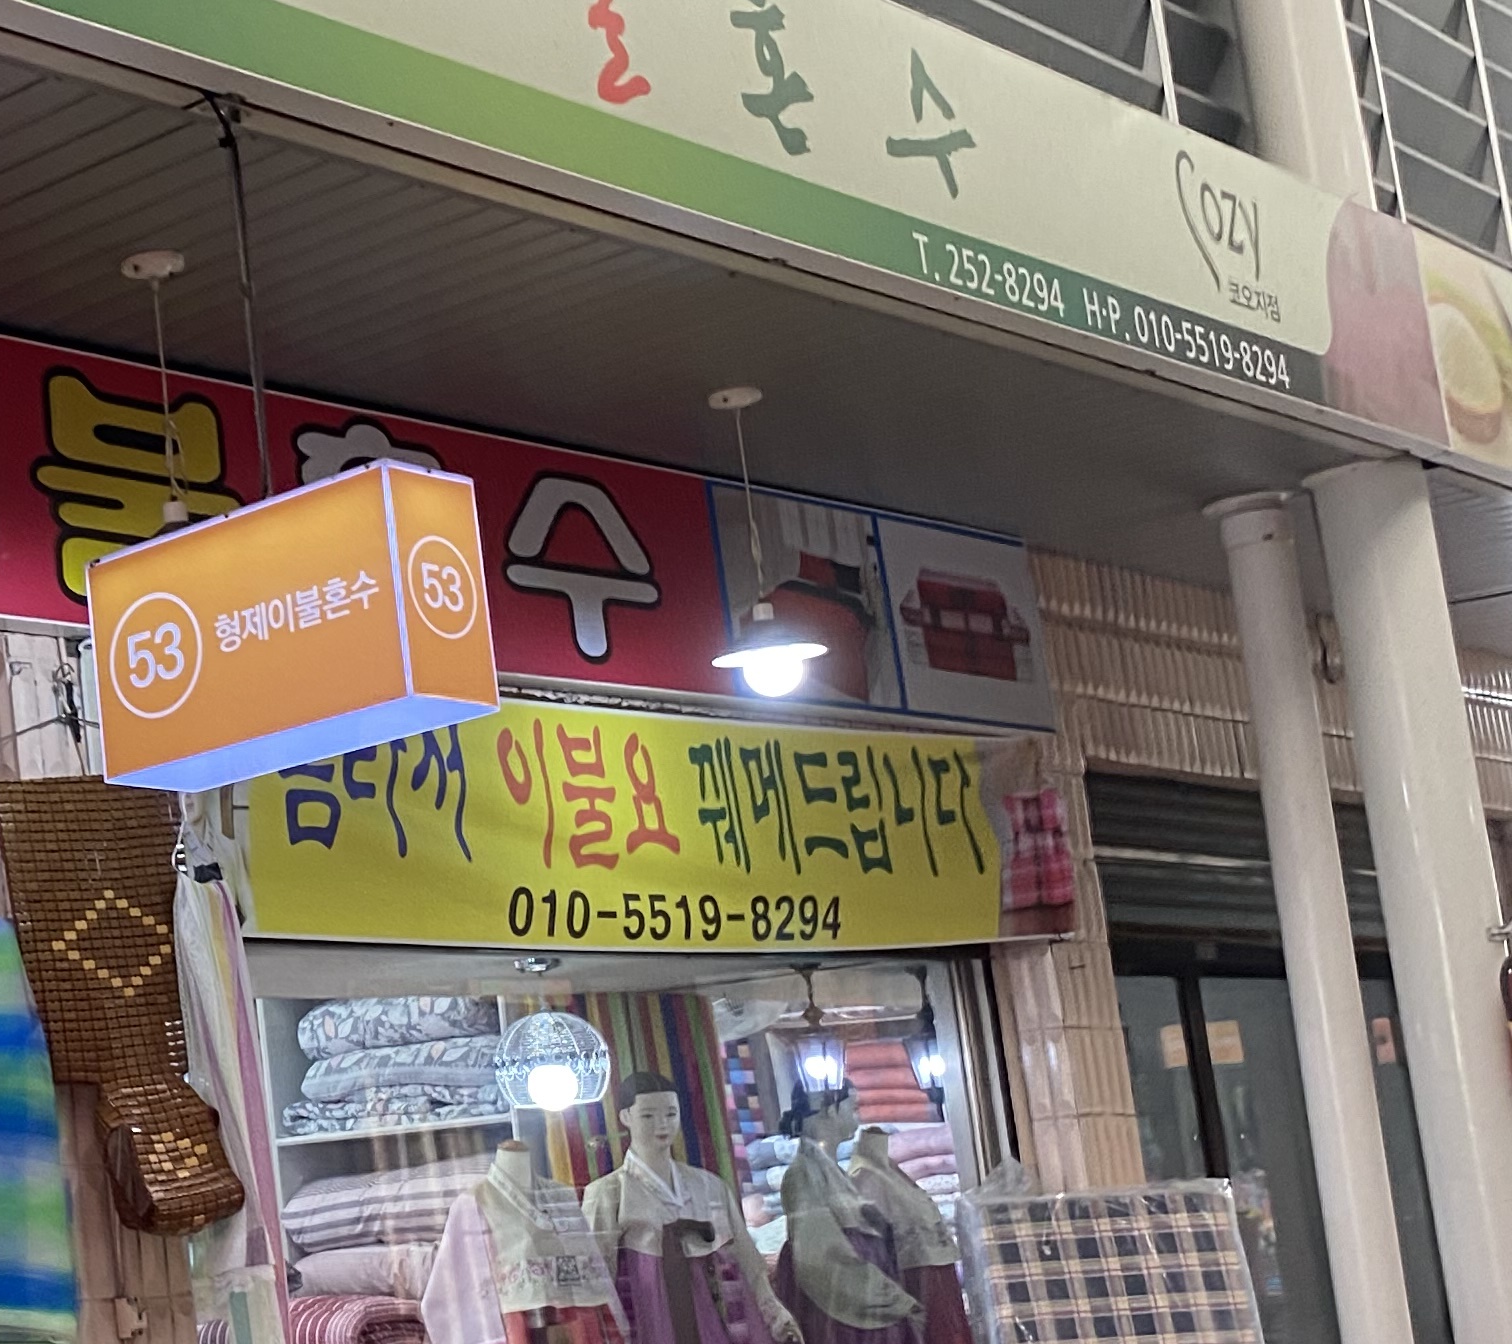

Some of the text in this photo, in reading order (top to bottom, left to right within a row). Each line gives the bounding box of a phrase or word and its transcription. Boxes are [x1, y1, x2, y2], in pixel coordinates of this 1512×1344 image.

[945, 243, 1066, 318] 252-8294
[1133, 305, 1291, 389] 010-5519-8294
[214, 570, 381, 653] 형제이불혼수
[420, 561, 465, 613] 53
[125, 621, 186, 689] 53
[508, 885, 842, 942] 010-5519-8294
